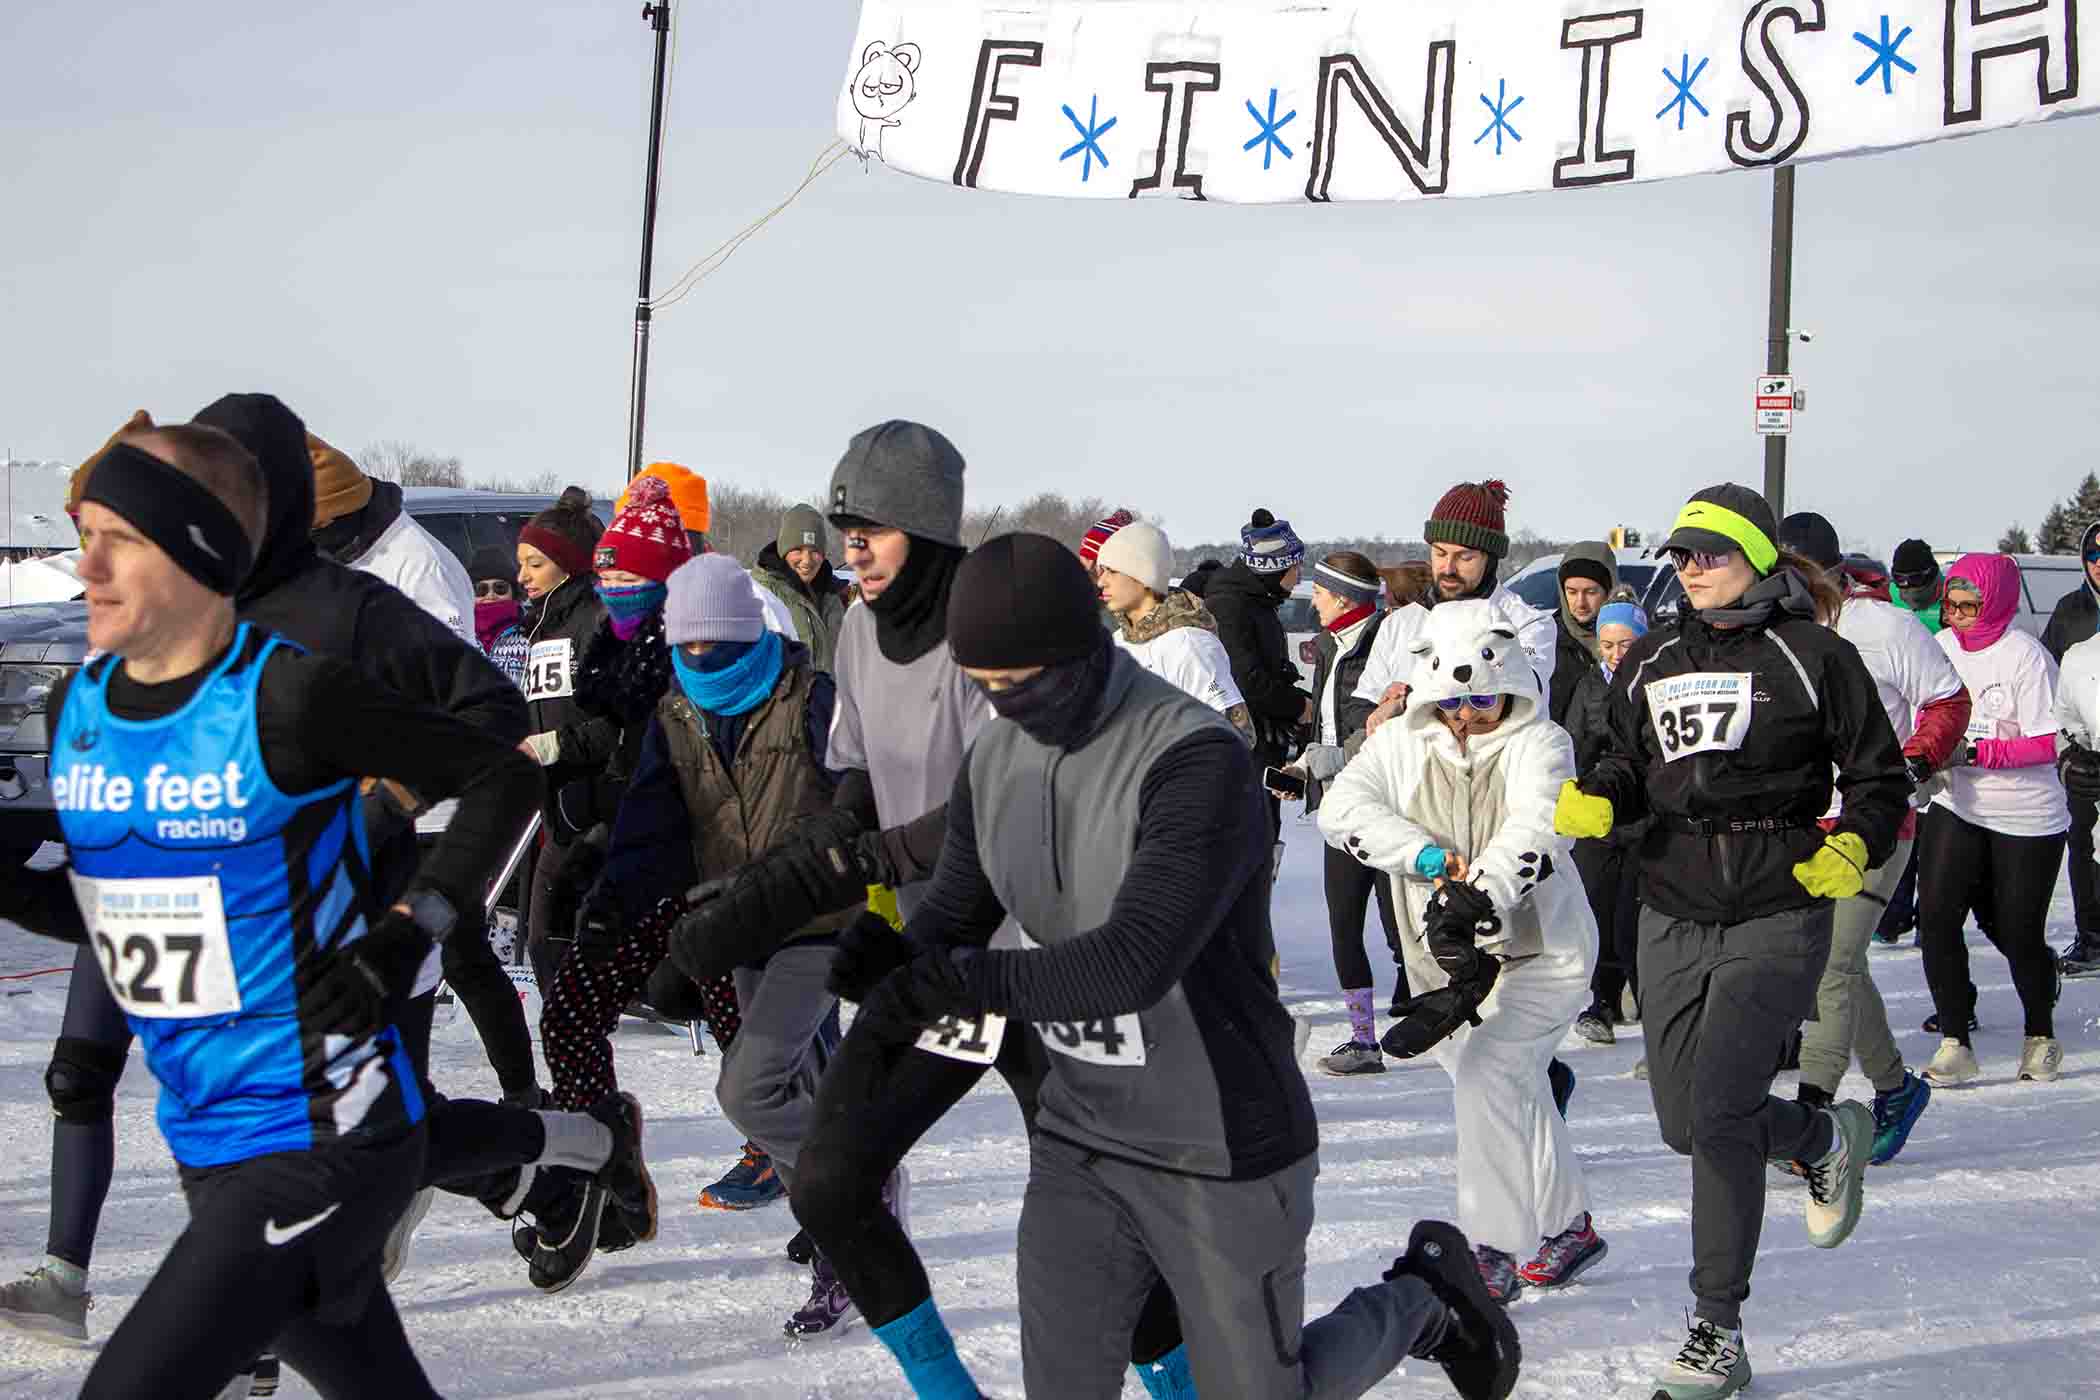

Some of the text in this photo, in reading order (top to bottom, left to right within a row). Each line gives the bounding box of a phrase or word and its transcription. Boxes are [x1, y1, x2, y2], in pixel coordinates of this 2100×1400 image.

[1660, 702, 1738, 752] 357
[53, 761, 248, 812] elite feet
[157, 814, 247, 841] racing
